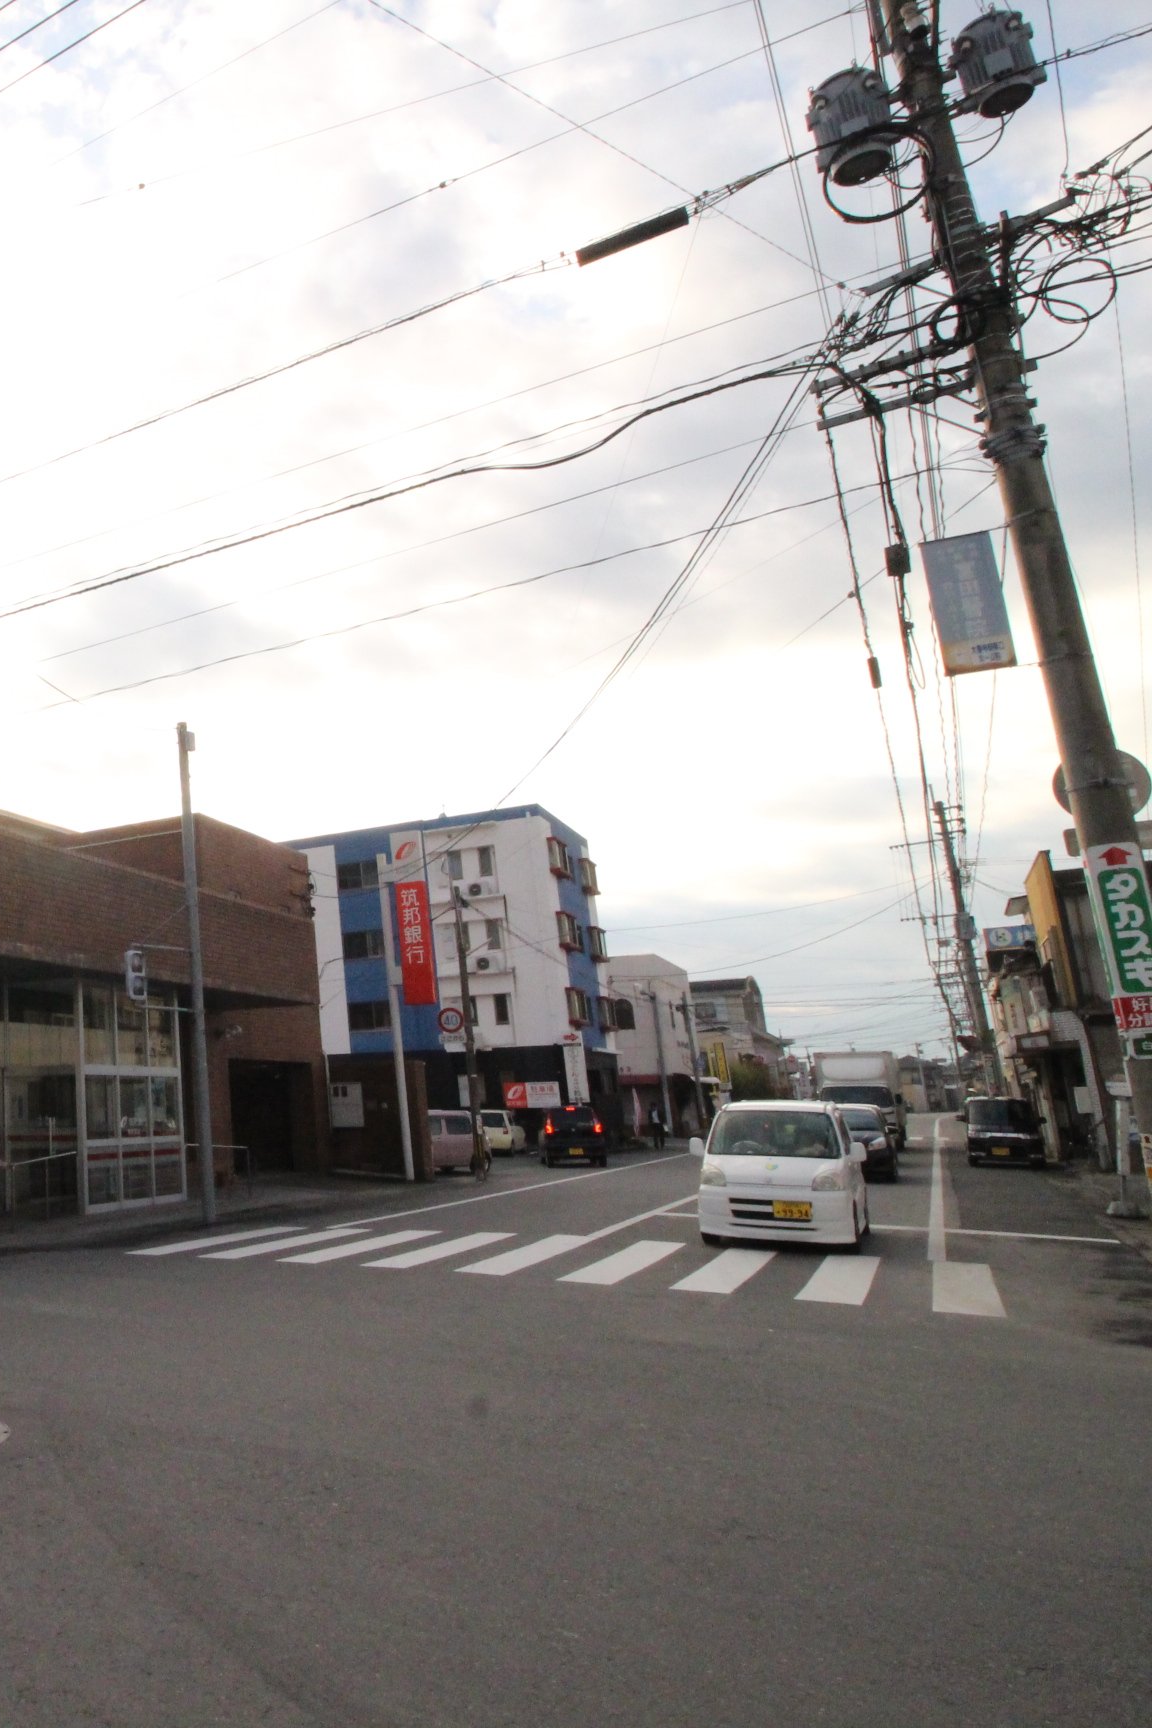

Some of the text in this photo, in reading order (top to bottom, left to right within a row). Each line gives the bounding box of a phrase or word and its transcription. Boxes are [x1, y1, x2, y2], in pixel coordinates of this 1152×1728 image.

[400, 888, 425, 965] 筑邦銀行
[444, 1015, 459, 1026] 40
